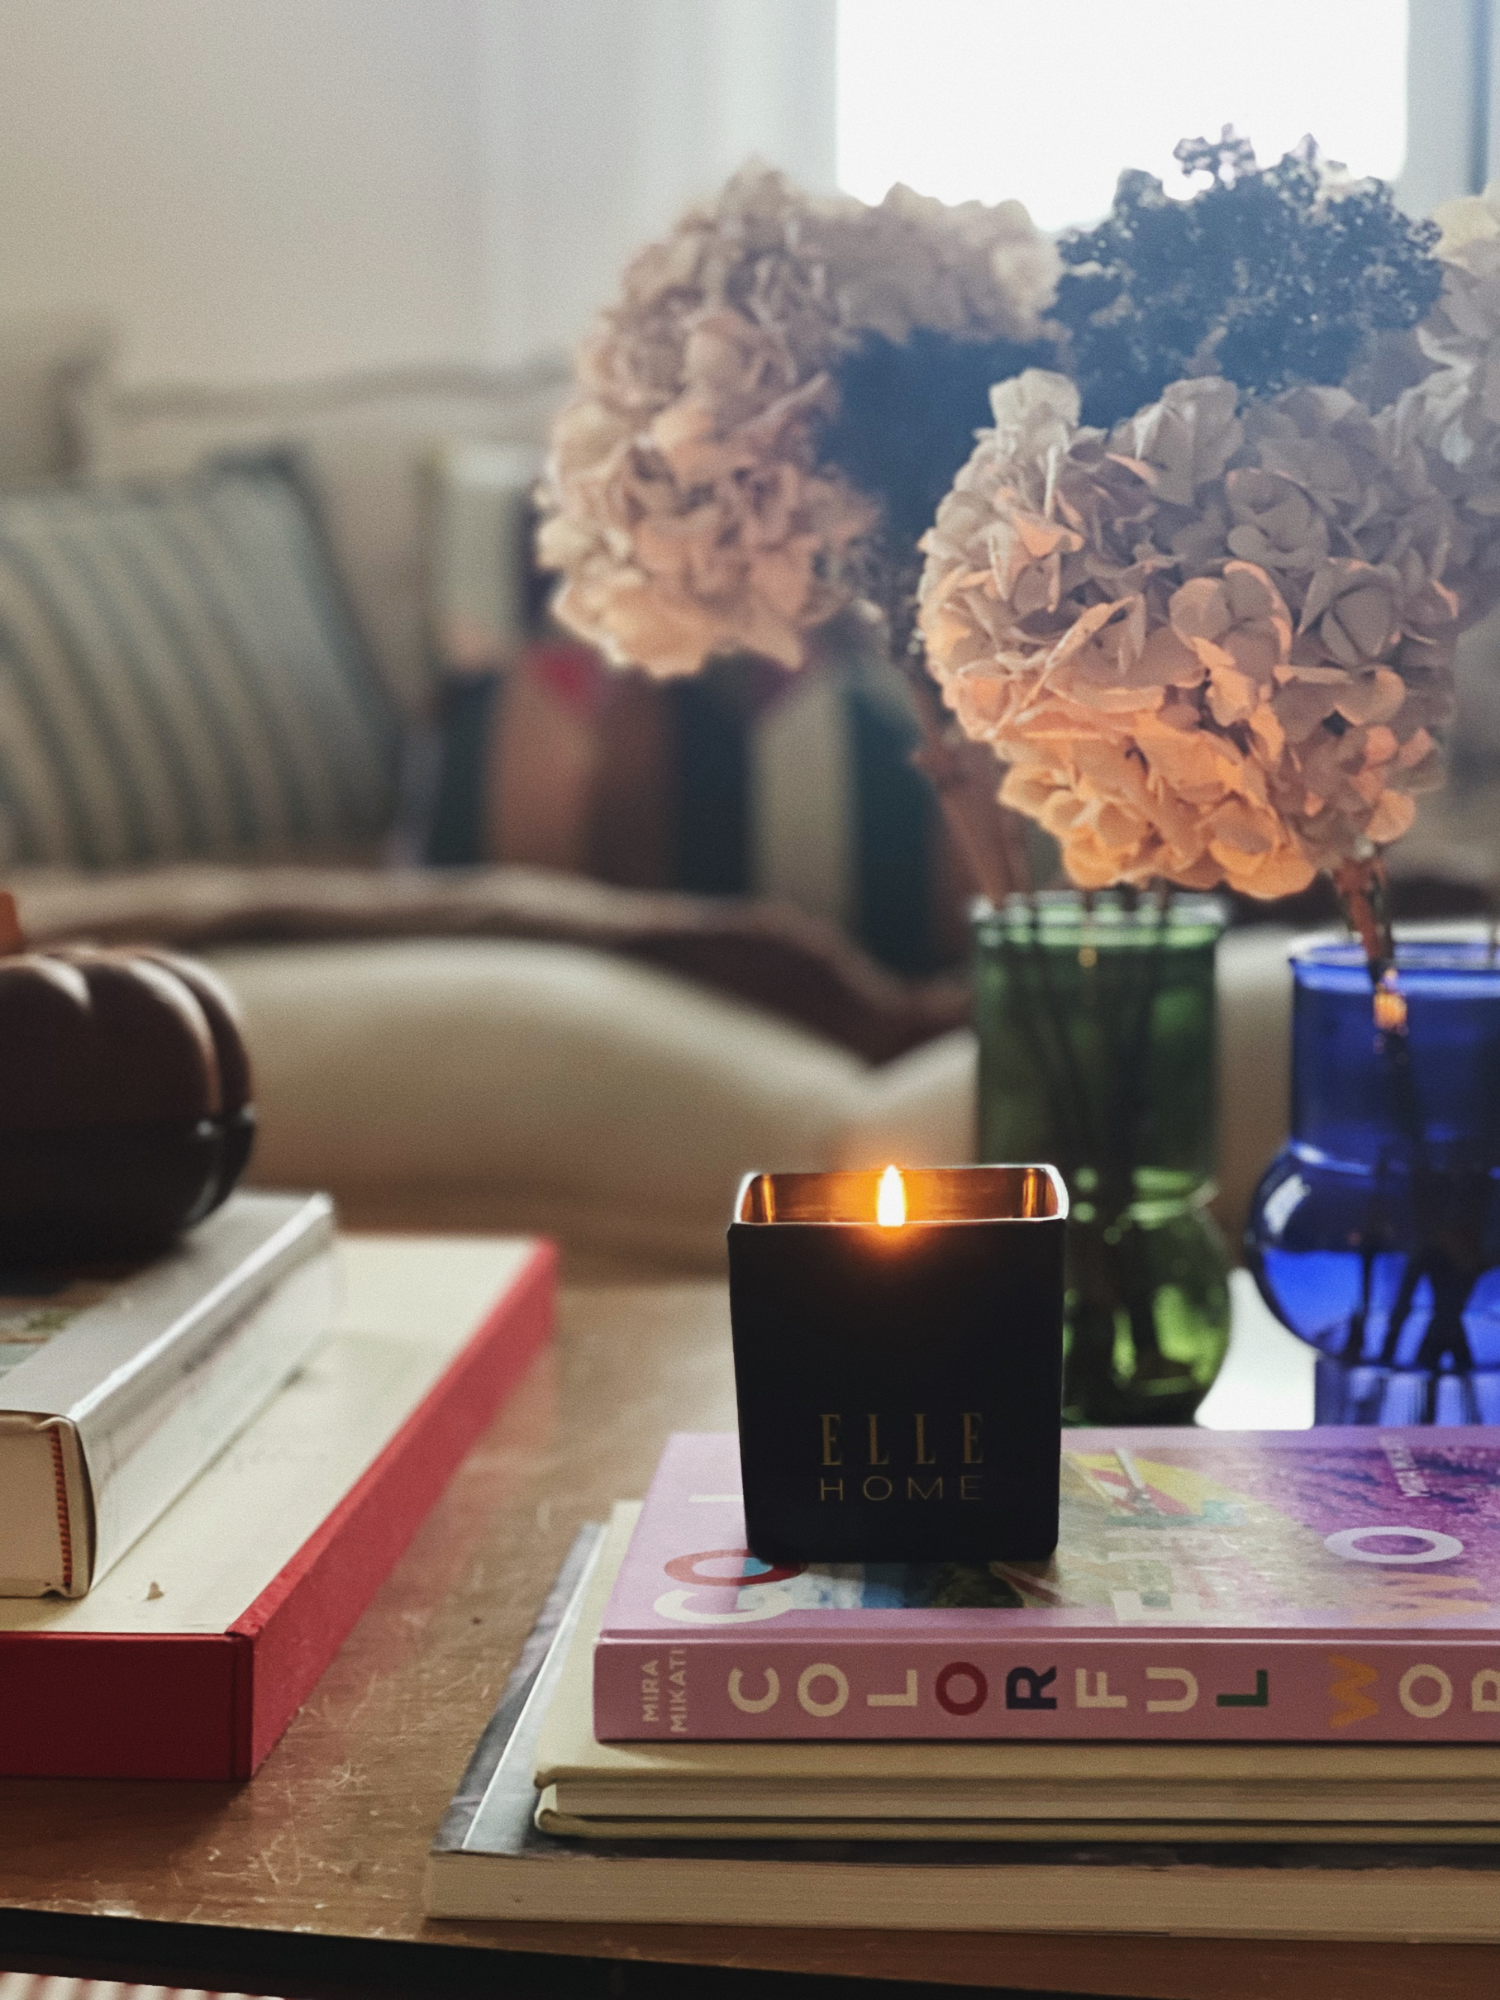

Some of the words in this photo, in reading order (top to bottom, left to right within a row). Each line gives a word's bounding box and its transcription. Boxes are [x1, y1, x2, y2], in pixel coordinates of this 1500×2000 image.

[819, 1413, 984, 1466] ELLE
[819, 1475, 983, 1501] HOME
[641, 1658, 660, 1723] MIRA
[669, 1648, 688, 1733] MIKATI
[727, 1660, 1270, 1718] COLORFUL
